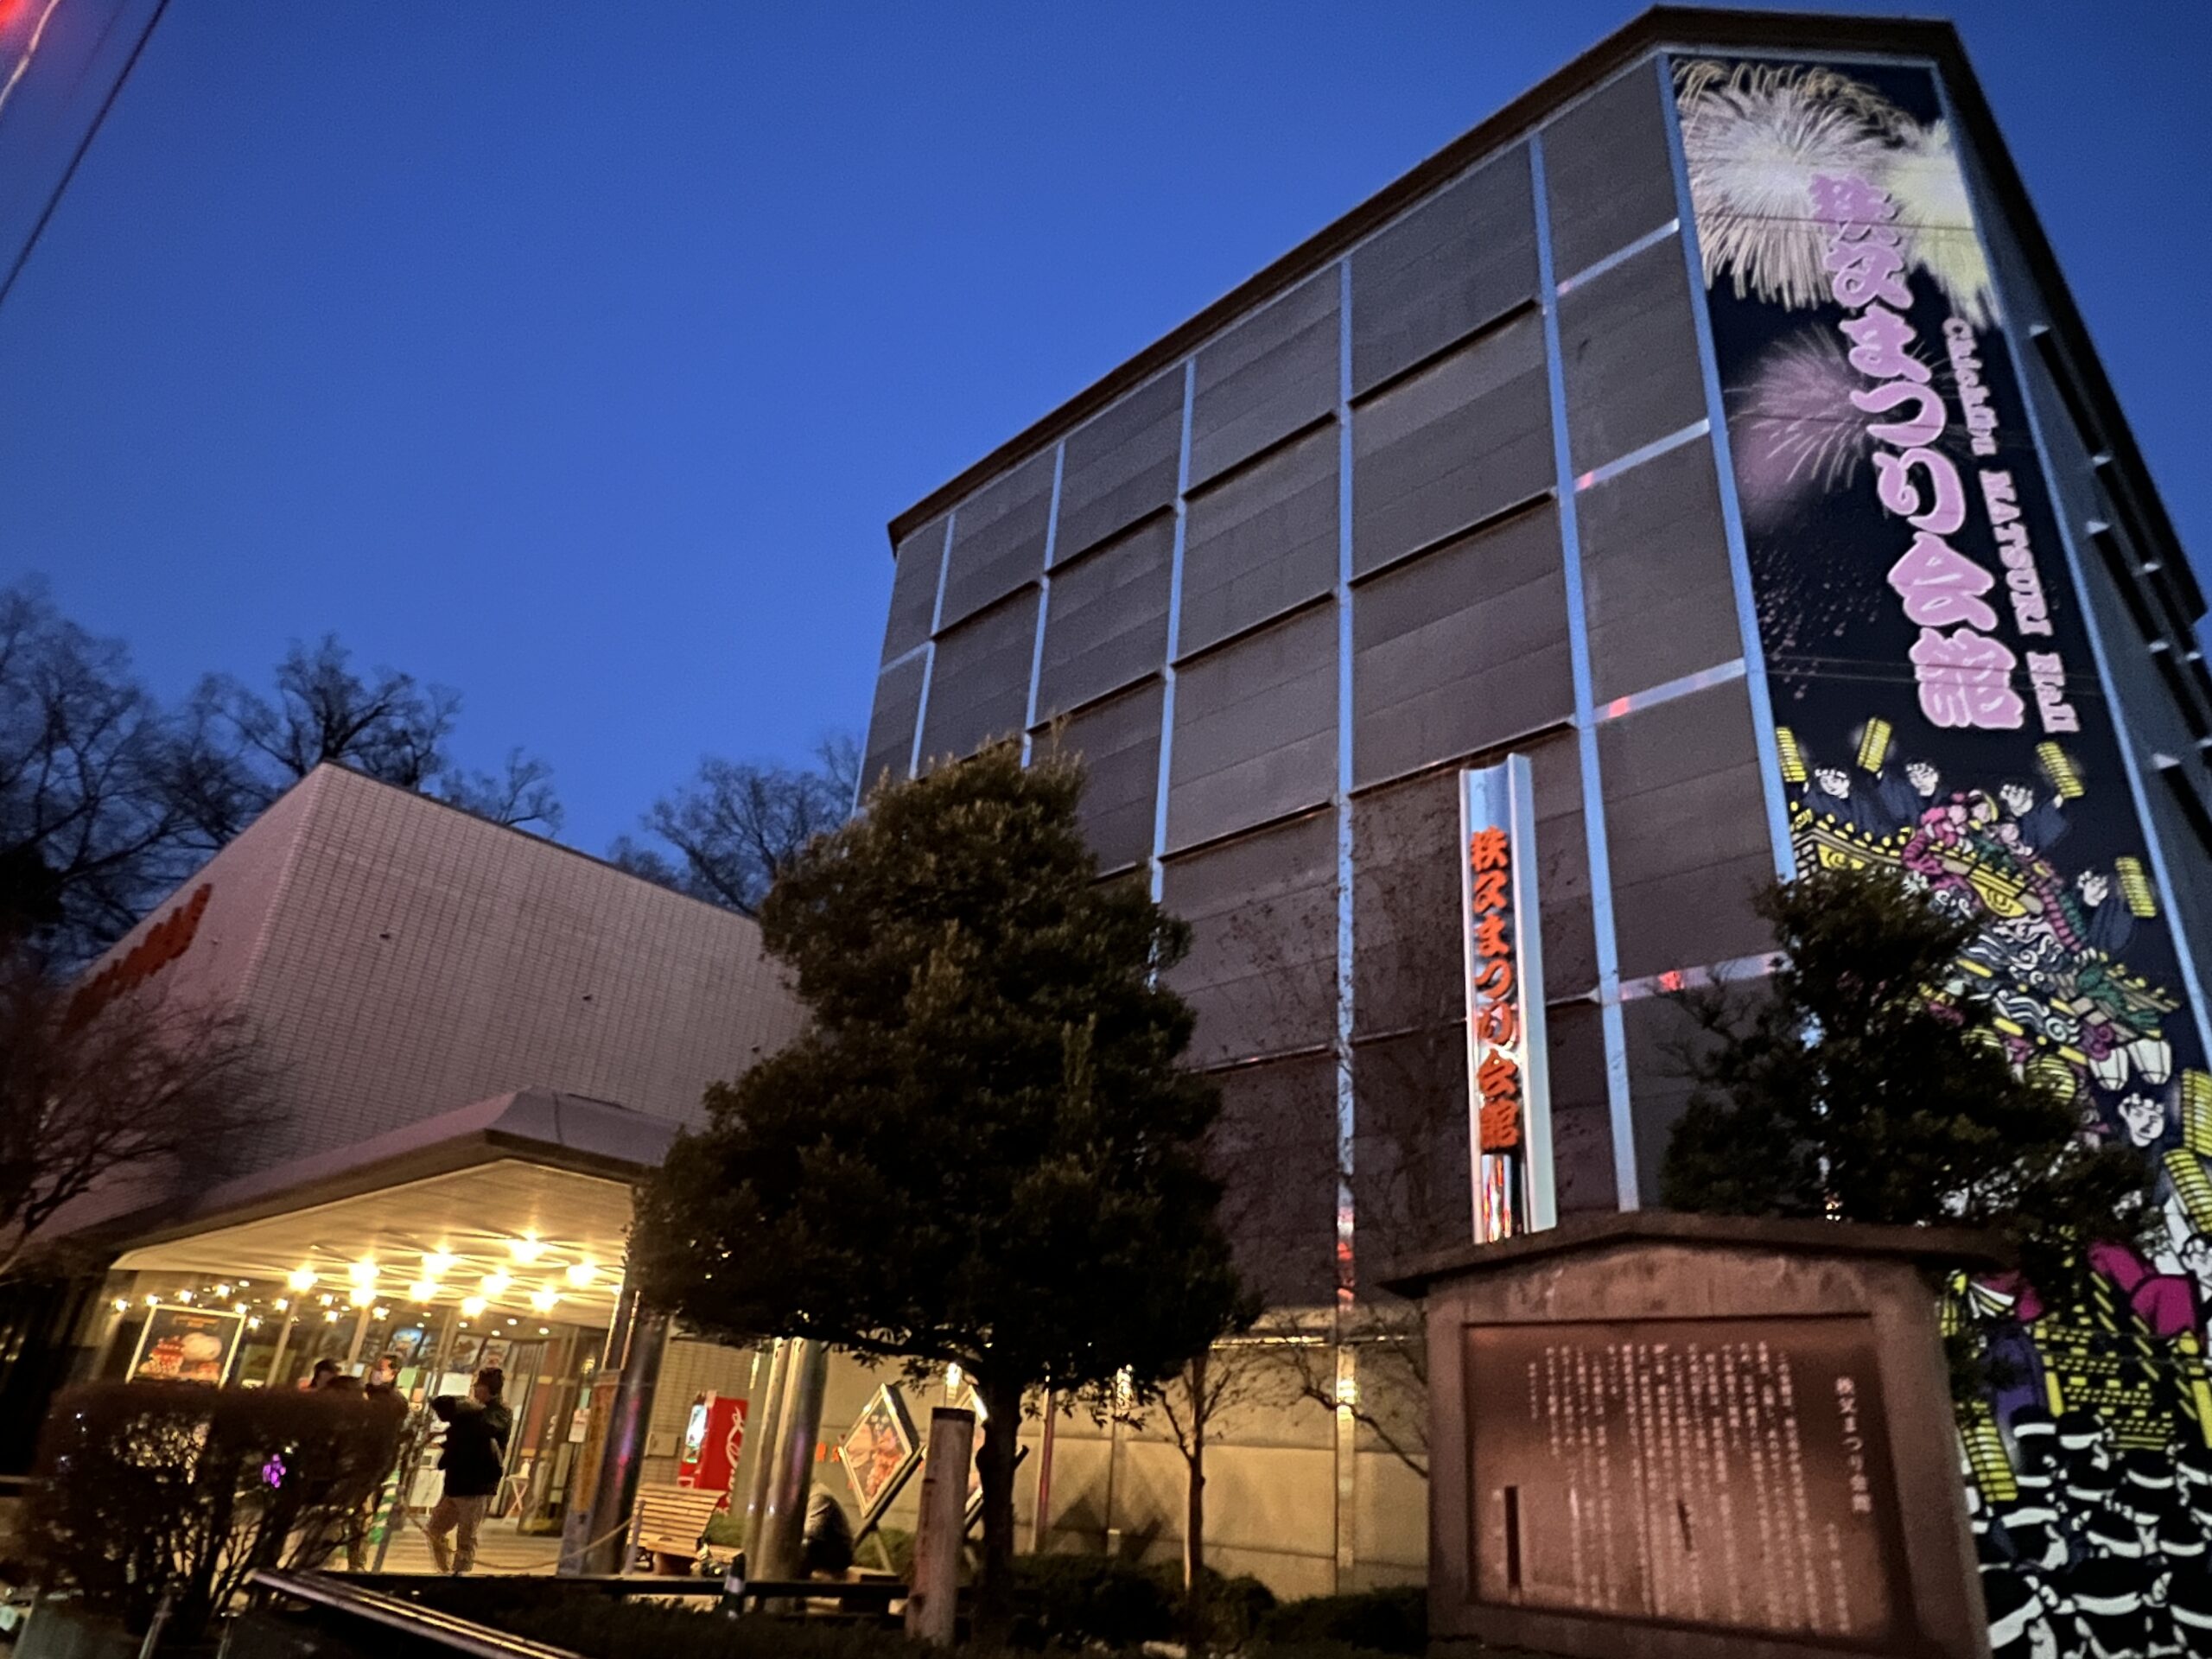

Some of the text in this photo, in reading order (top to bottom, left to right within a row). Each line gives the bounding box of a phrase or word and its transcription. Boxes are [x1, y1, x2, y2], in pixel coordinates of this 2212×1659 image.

[1808, 172, 2024, 729] 秩父まつり会館
[1979, 469, 2053, 636] MATSURI
[2026, 652, 2080, 733] Hall
[1470, 824, 1521, 1151] 秩父まつり会館
